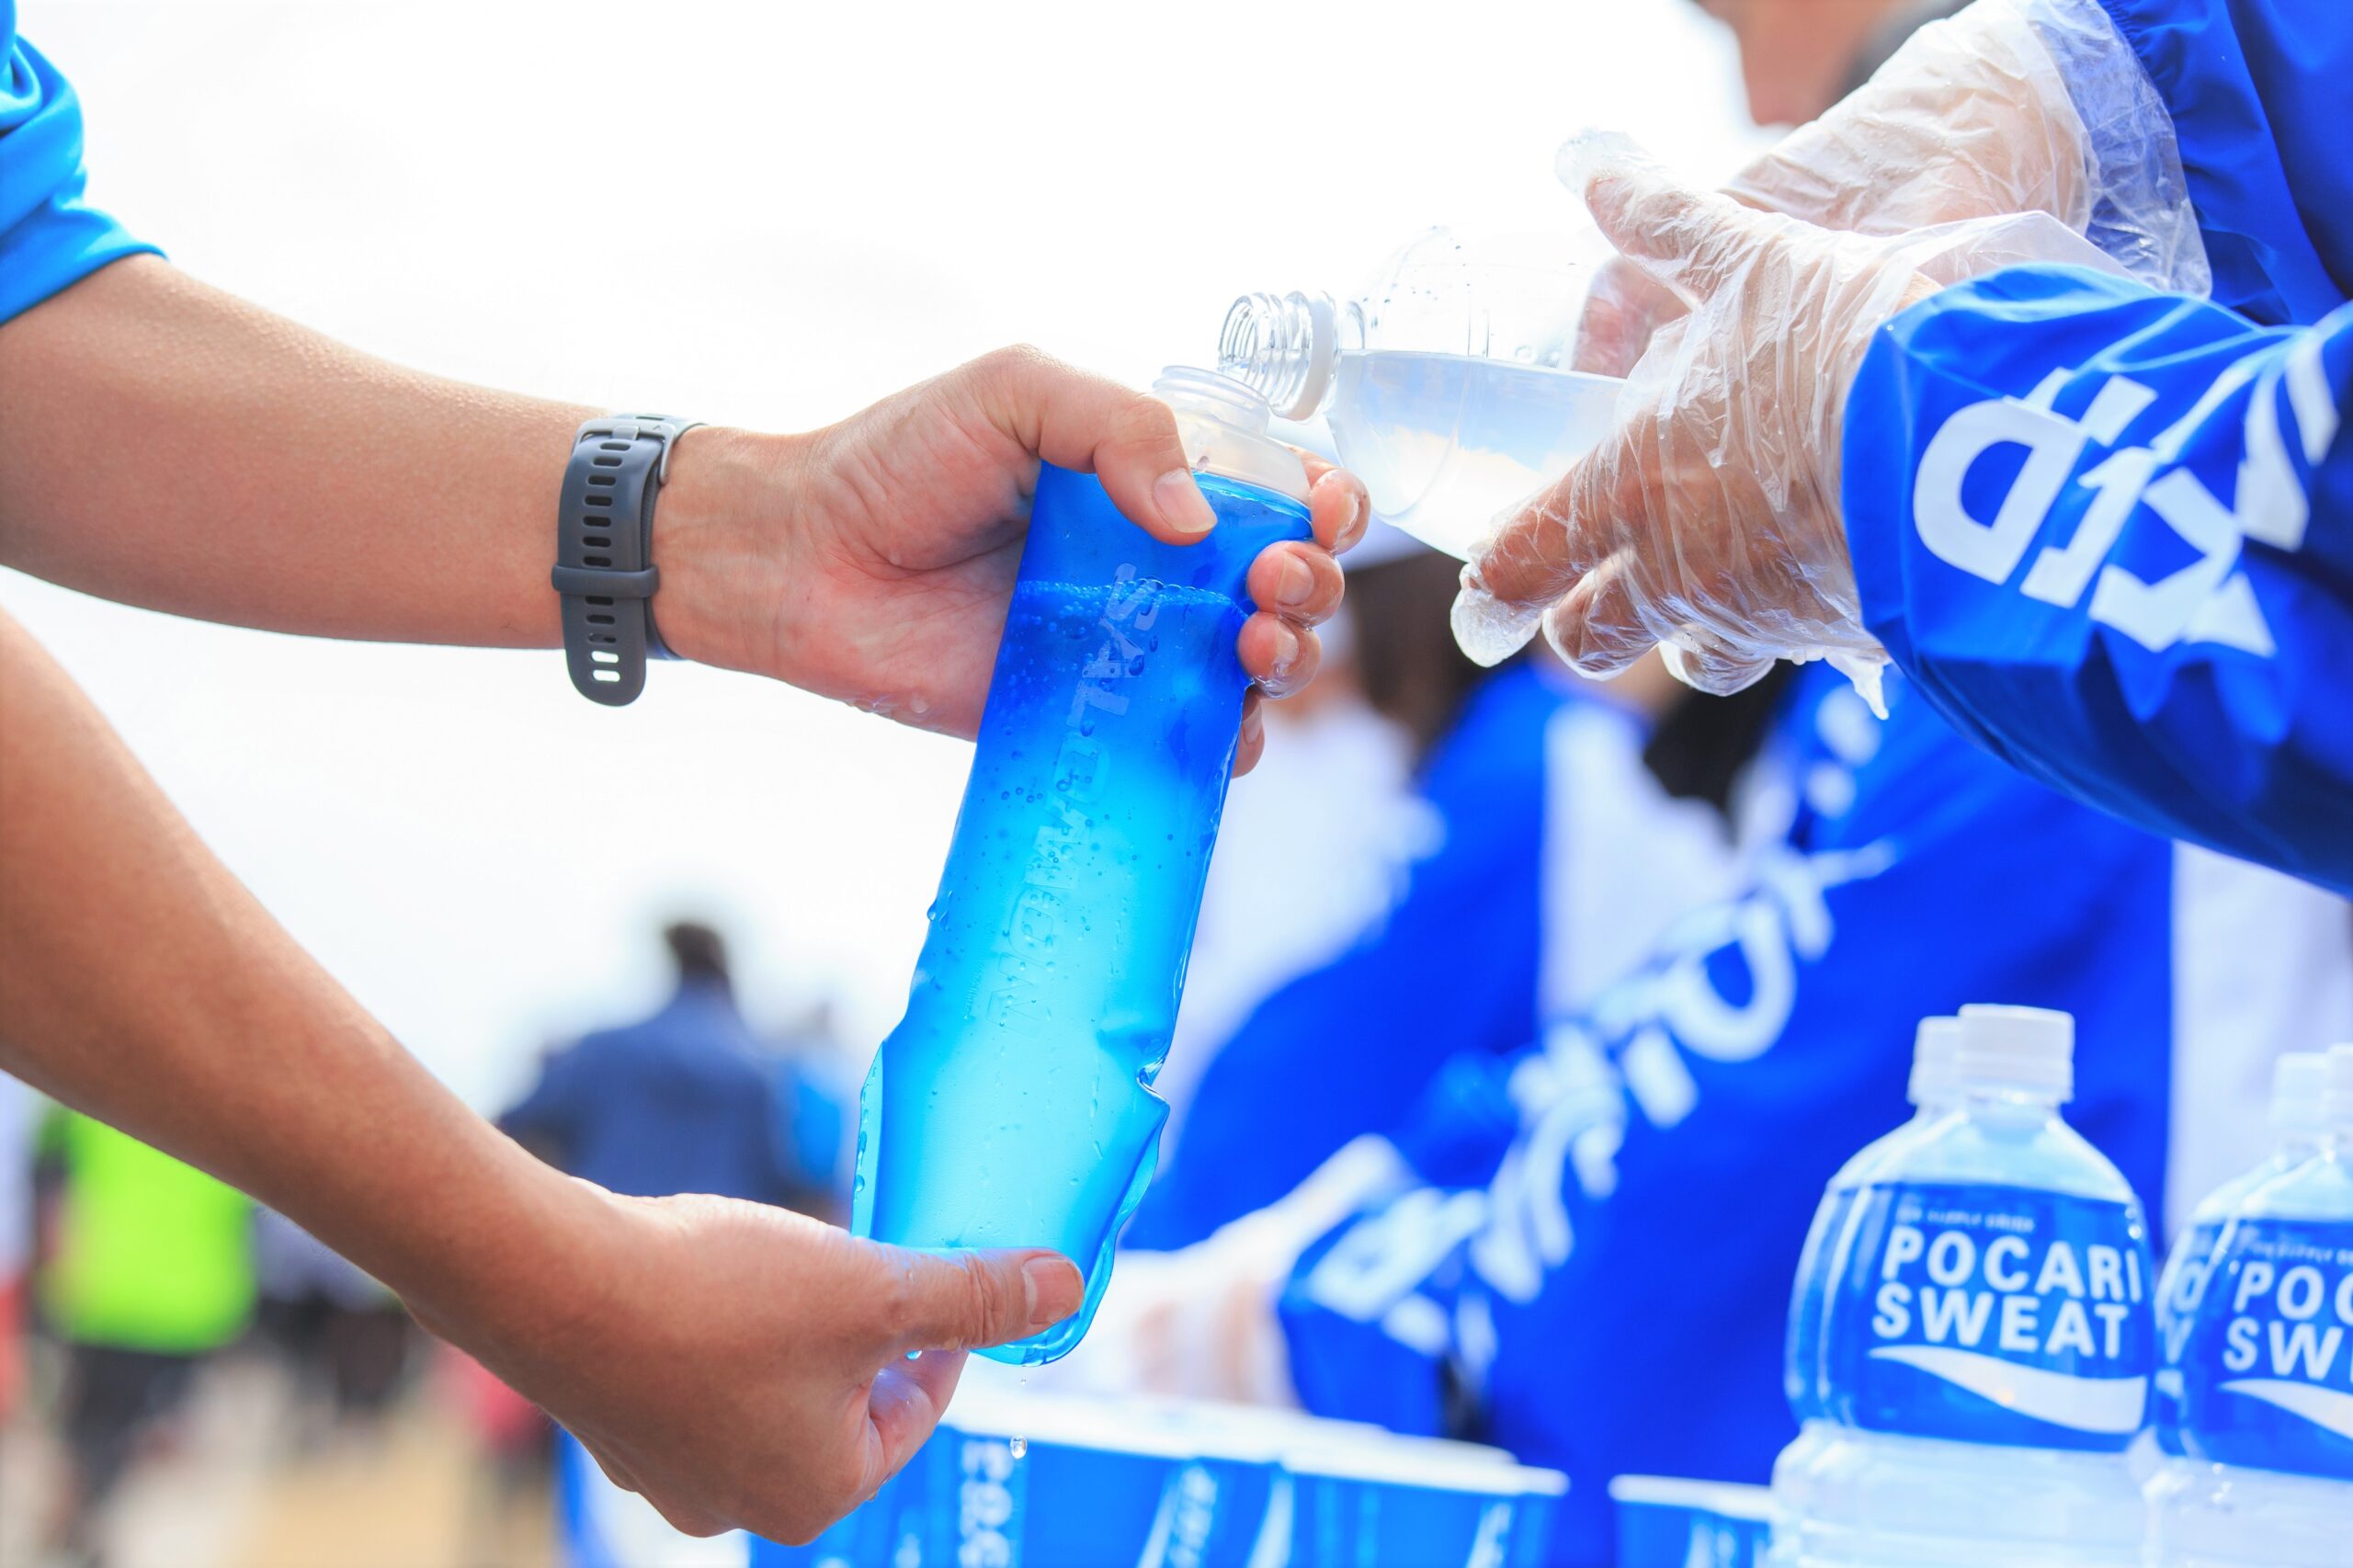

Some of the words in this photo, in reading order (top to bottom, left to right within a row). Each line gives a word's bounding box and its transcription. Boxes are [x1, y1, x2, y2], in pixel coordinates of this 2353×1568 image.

[986, 562, 1162, 1035] SALOMON
[1881, 1226, 2143, 1303] POCARI
[1871, 1282, 2130, 1359] SWEAT
[2222, 1315, 2353, 1383] SW
